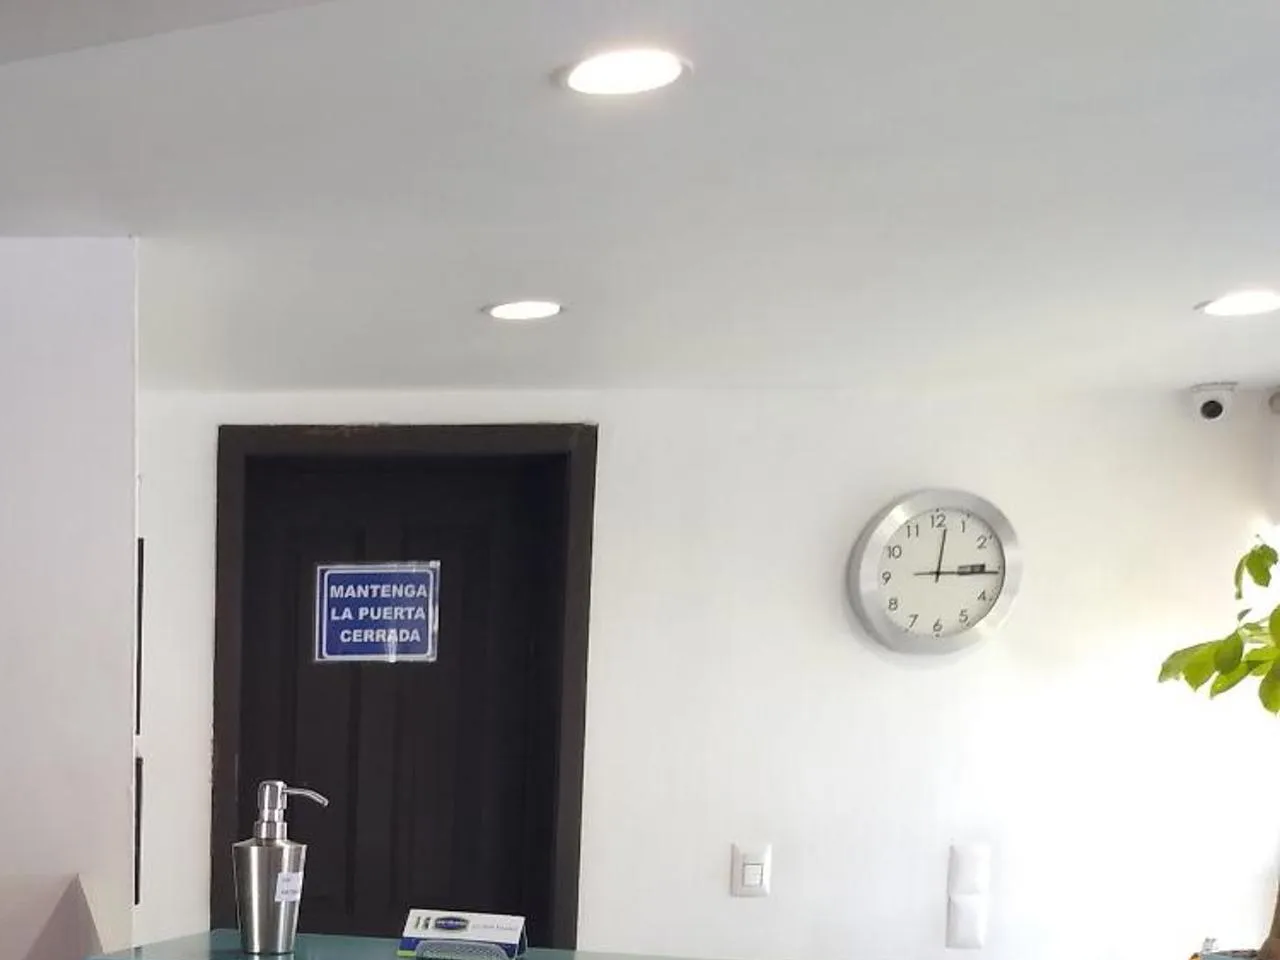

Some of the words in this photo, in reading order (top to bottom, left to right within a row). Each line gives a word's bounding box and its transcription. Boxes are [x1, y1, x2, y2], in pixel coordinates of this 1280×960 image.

[930, 514, 946, 529] 12
[907, 524, 919, 539] 11
[976, 535, 987, 549] 2
[888, 545, 902, 559] 10
[882, 571, 891, 585] 9
[330, 584, 427, 598] MANTENGA
[977, 590, 986, 601] 4
[888, 598, 898, 611] 8
[330, 607, 352, 620] LA
[358, 606, 426, 620] PUERTA
[959, 609, 968, 623] 5
[908, 614, 919, 628] 7
[933, 618, 943, 632] 6
[339, 628, 421, 642] CERRADA
